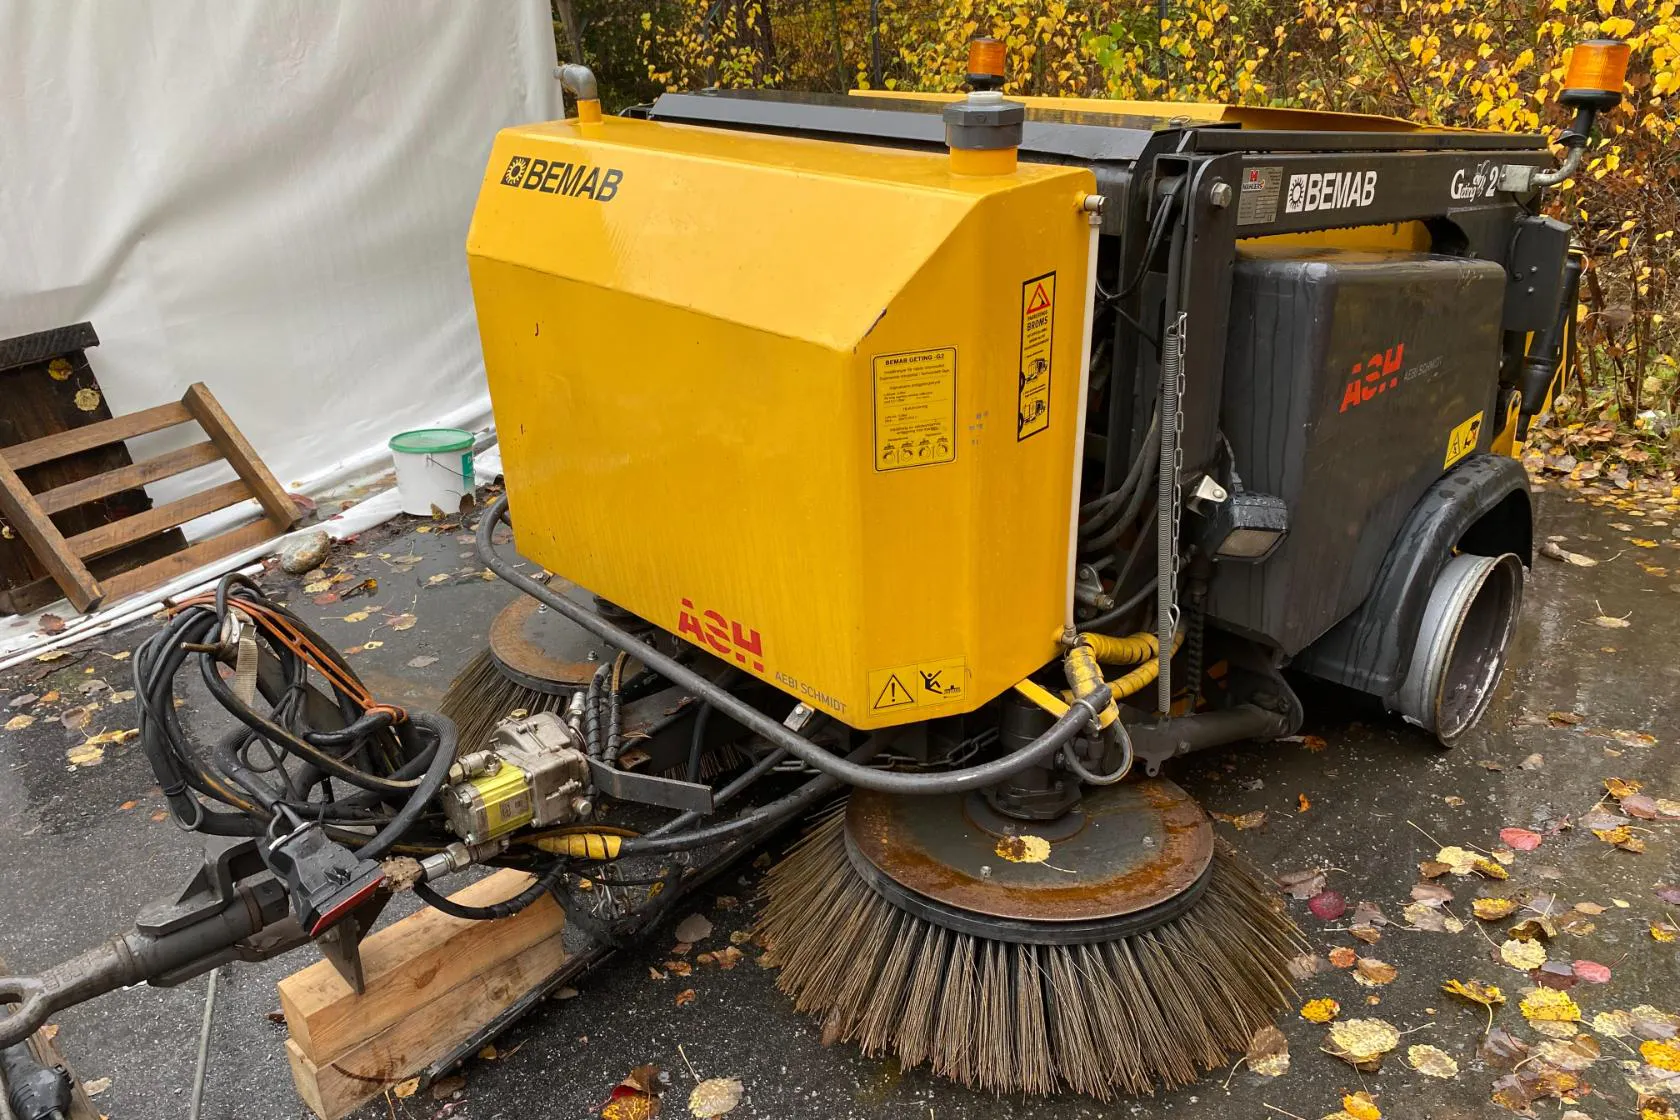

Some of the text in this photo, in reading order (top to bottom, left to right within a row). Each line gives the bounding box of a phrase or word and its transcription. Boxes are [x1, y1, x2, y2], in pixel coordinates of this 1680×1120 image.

[522, 158, 624, 202] BEMAB
[1304, 170, 1378, 212] BEMAB
[1485, 166, 1499, 197] 2
[1026, 315, 1049, 332] BROMS
[678, 597, 765, 674] ASH
[775, 671, 847, 715] AEBI SCHMIDT
